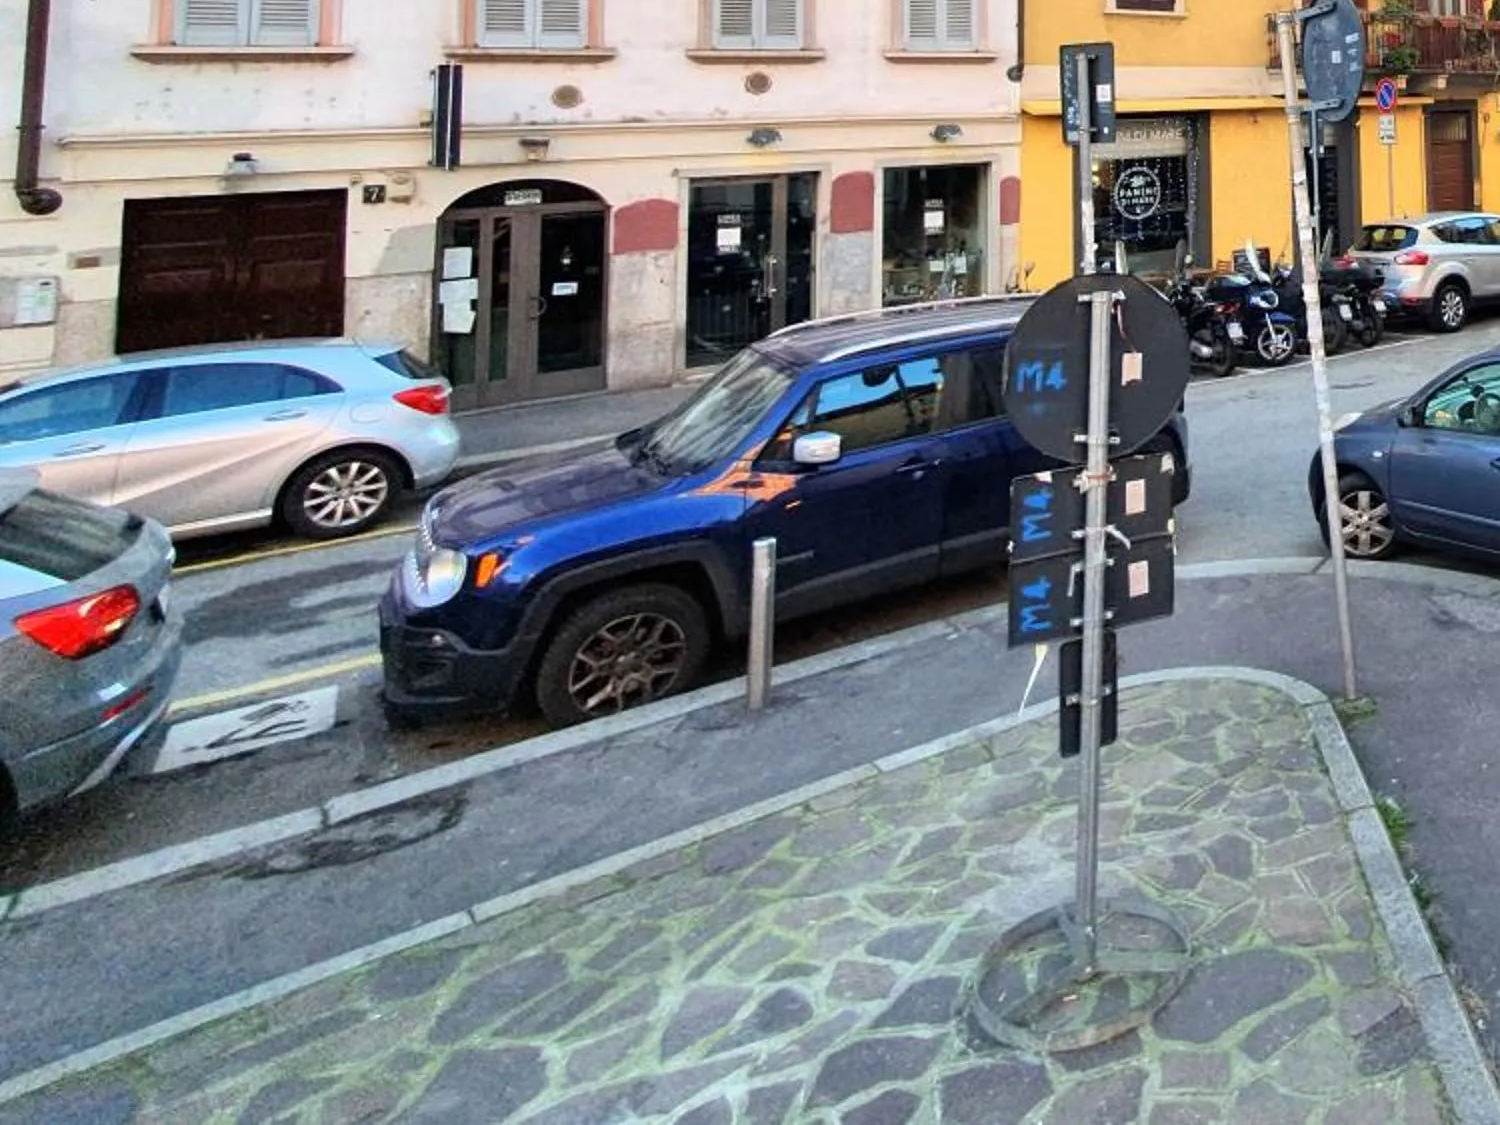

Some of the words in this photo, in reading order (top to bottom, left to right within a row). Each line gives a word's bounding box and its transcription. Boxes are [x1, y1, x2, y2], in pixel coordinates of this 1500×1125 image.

[368, 187, 379, 202] 7
[1016, 362, 1067, 392] M4
[1022, 486, 1052, 542] M4
[1021, 577, 1051, 632] M4
